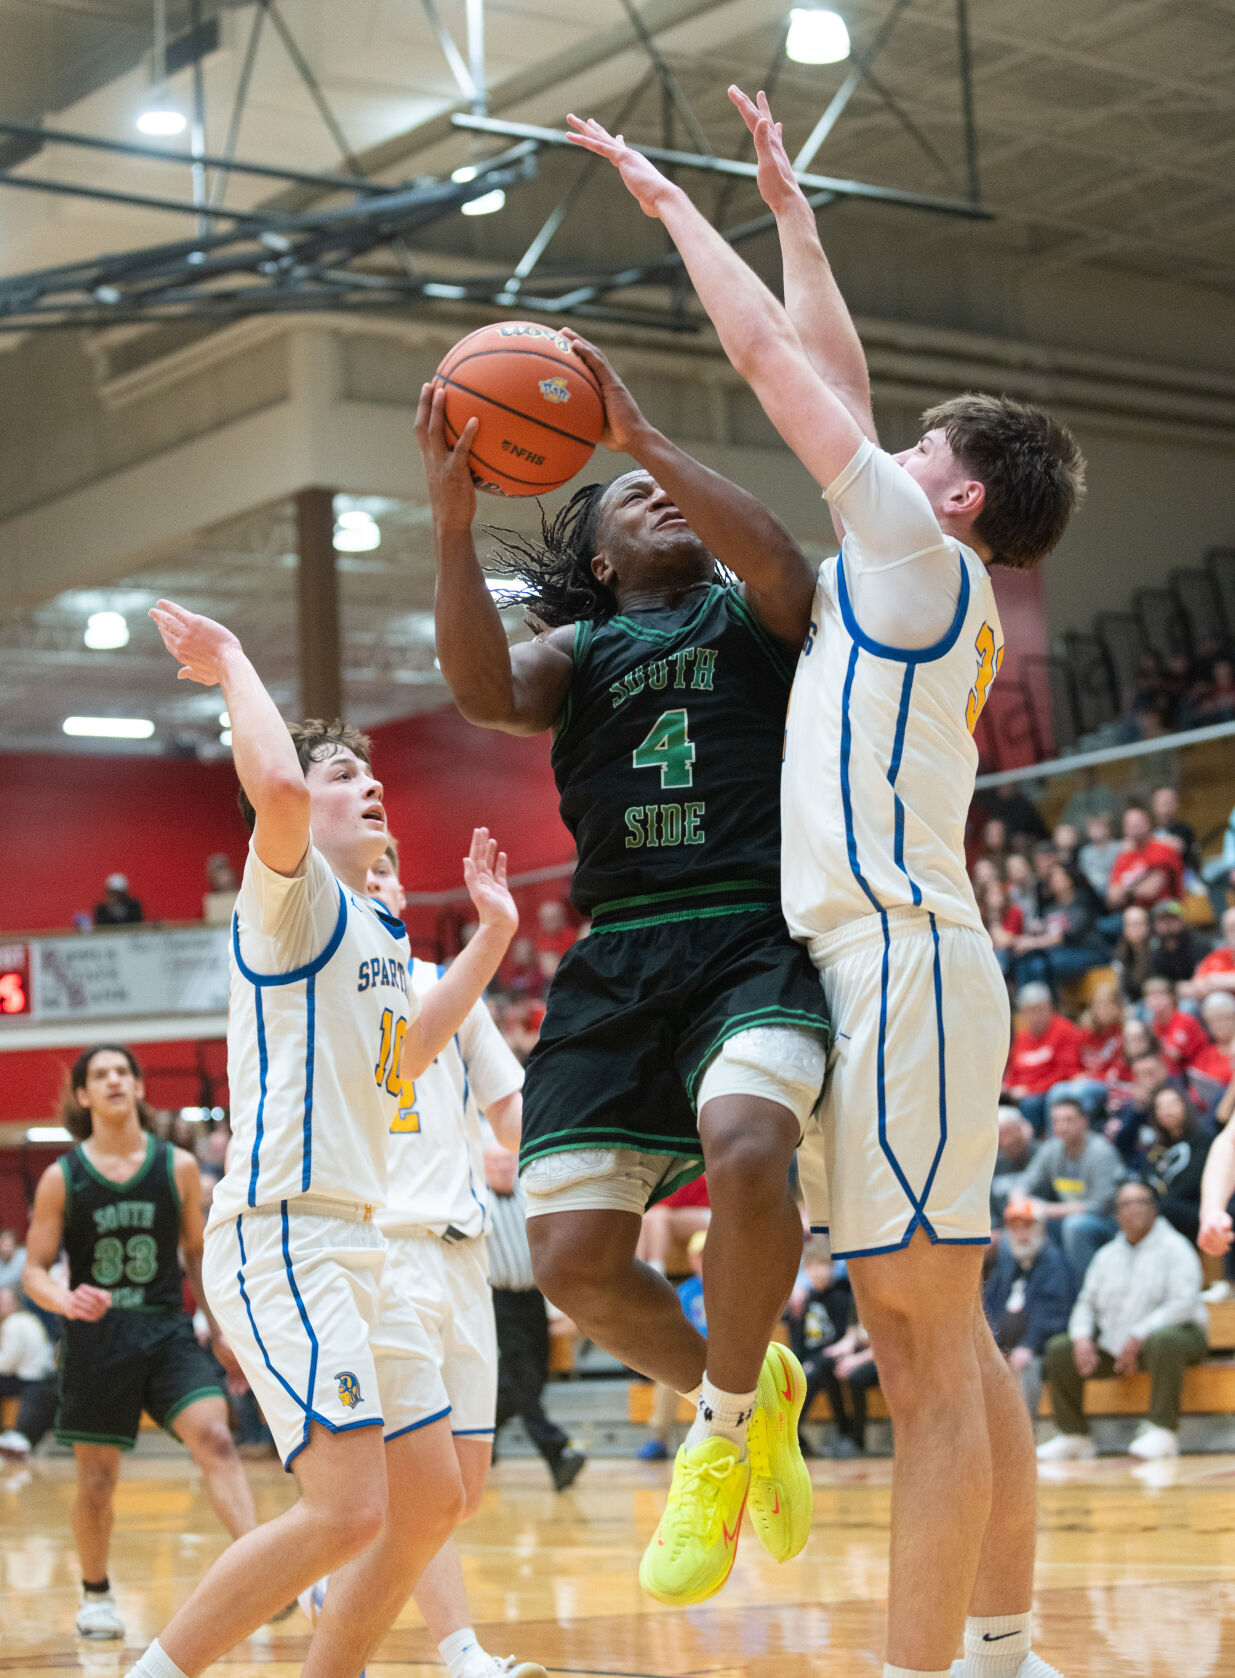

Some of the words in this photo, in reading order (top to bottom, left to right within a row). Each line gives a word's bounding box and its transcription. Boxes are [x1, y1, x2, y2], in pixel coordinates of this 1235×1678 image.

[510, 444, 545, 466] NFHS
[609, 647, 718, 708] SOUTH
[632, 708, 696, 789] 4
[624, 801, 705, 848] SIDE
[91, 1233, 158, 1286] 33
